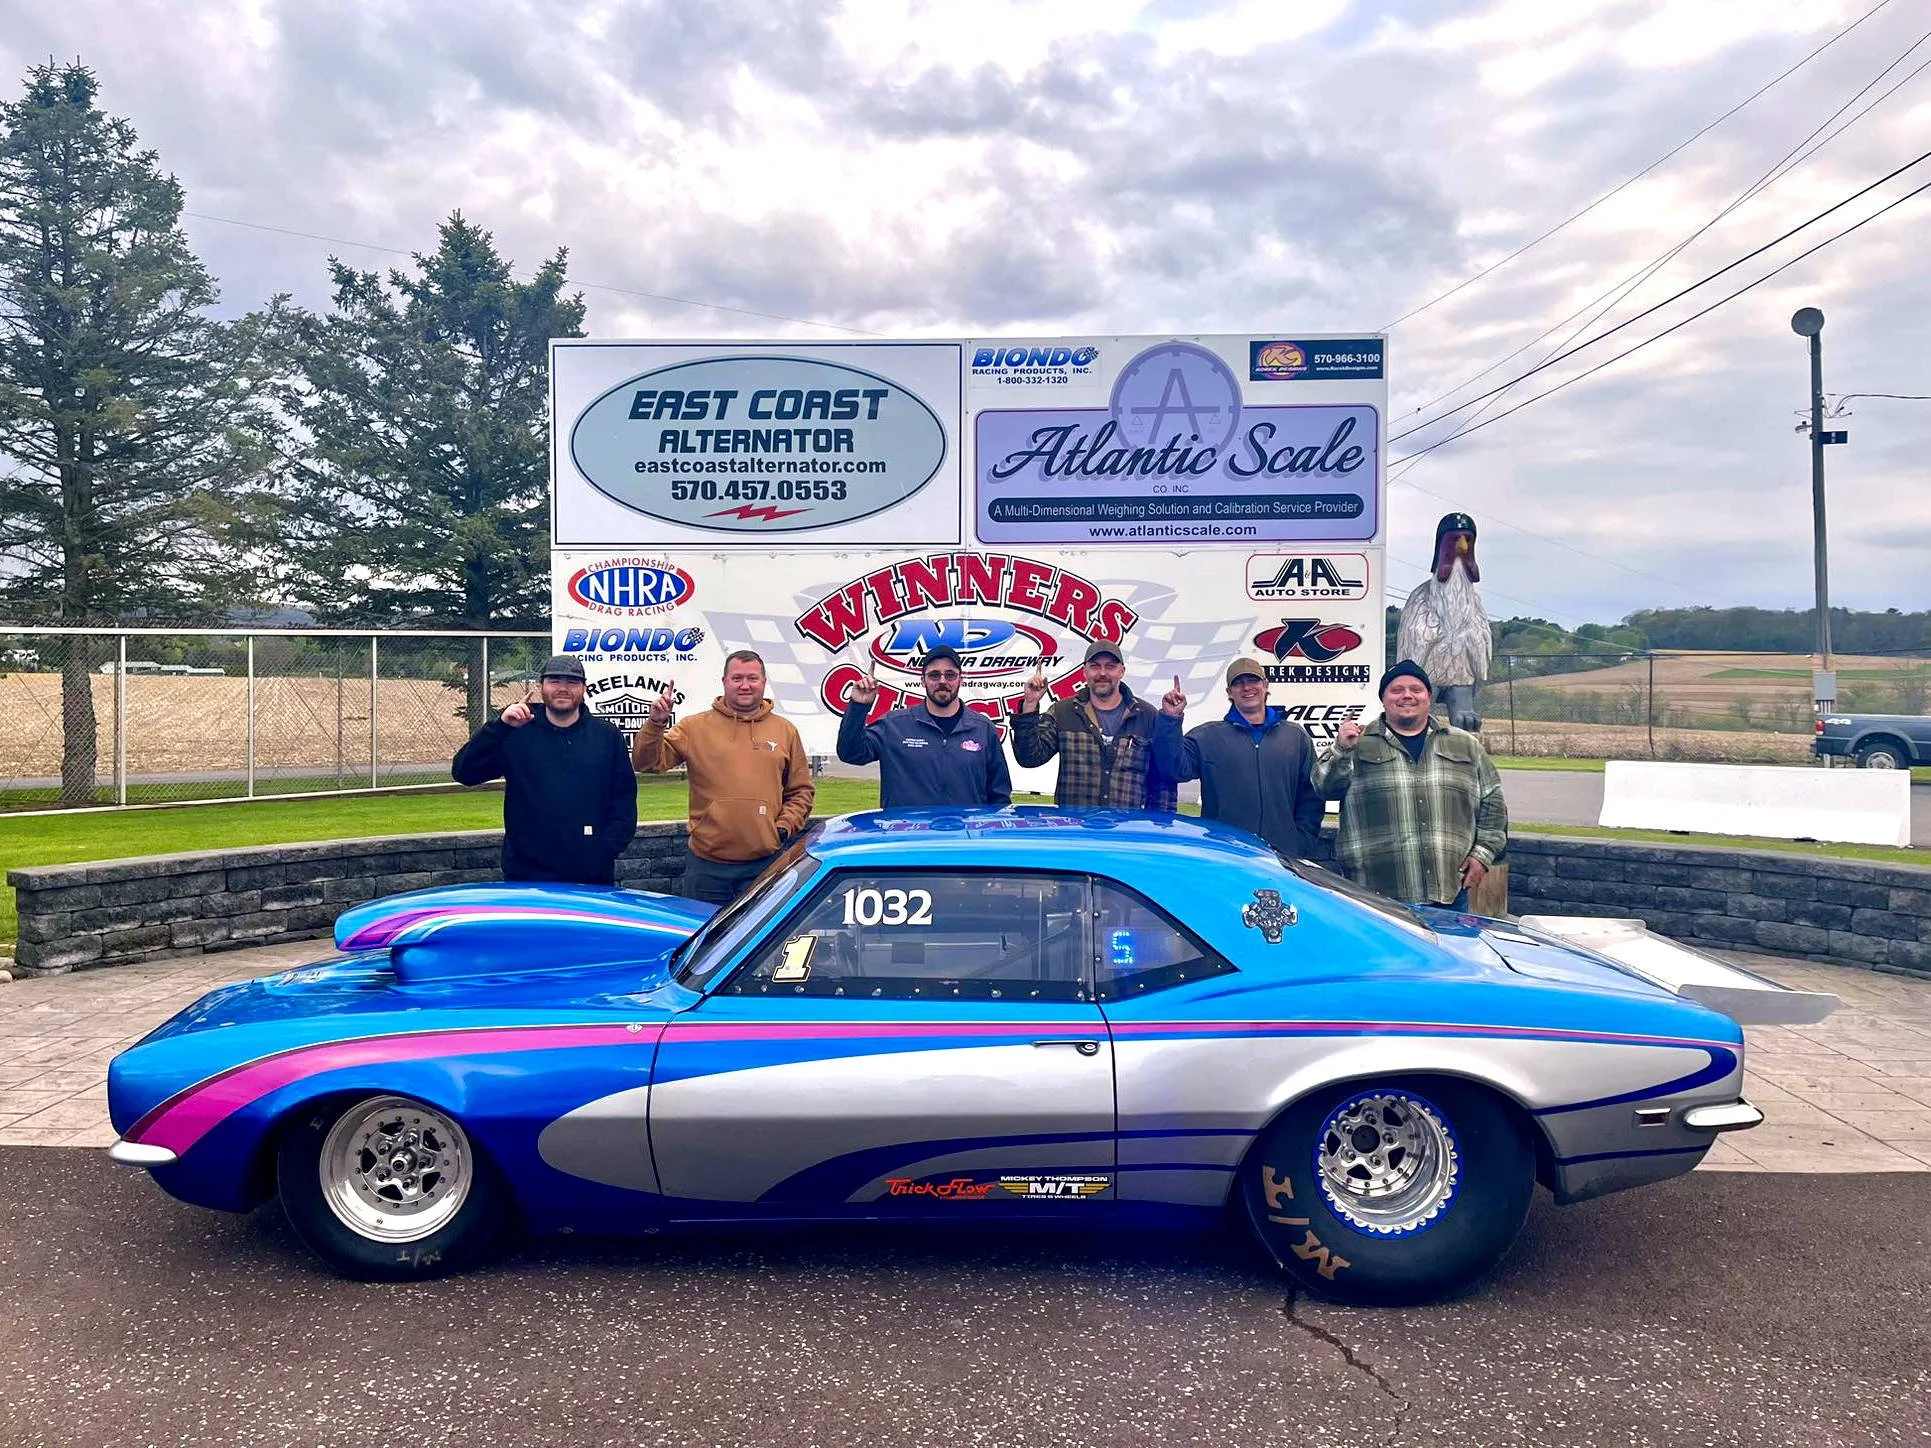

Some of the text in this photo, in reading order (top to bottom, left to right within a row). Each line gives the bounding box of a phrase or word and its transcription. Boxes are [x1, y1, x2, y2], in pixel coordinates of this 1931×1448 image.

[972, 347, 1097, 367] BIONDO
[1314, 353, 1380, 364] 570-966-3100
[972, 368, 1008, 376] RACING
[1013, 367, 1067, 375] PRODUCTS,
[997, 376, 1068, 384] 1-800-332-1320
[628, 389, 889, 420] EAST COAST
[658, 428, 855, 453] ALTERNATOR
[990, 416, 1366, 479] Atlantic Scale
[634, 457, 887, 474] eastcoastalternator.com
[672, 480, 847, 500] 570.457.0553
[994, 501, 1358, 517] A Multi-Dimensional Weighing Solution and Calibration Service Provider
[1089, 525, 1257, 537] www.atlanticscale.com
[588, 557, 676, 573] CHAMPIONSHIP
[589, 568, 677, 606] NHRA
[1301, 588, 1351, 596] STORE
[588, 602, 675, 617] DRAG RACING
[795, 552, 1139, 654] WINNERS
[563, 627, 704, 652] BIONDO
[573, 653, 698, 663] CING PRODUCTS, INC.
[1305, 666, 1369, 676] DESIGNS
[841, 889, 934, 926] 1032
[772, 934, 818, 982] 1
[1029, 1182, 1085, 1194] M/T
